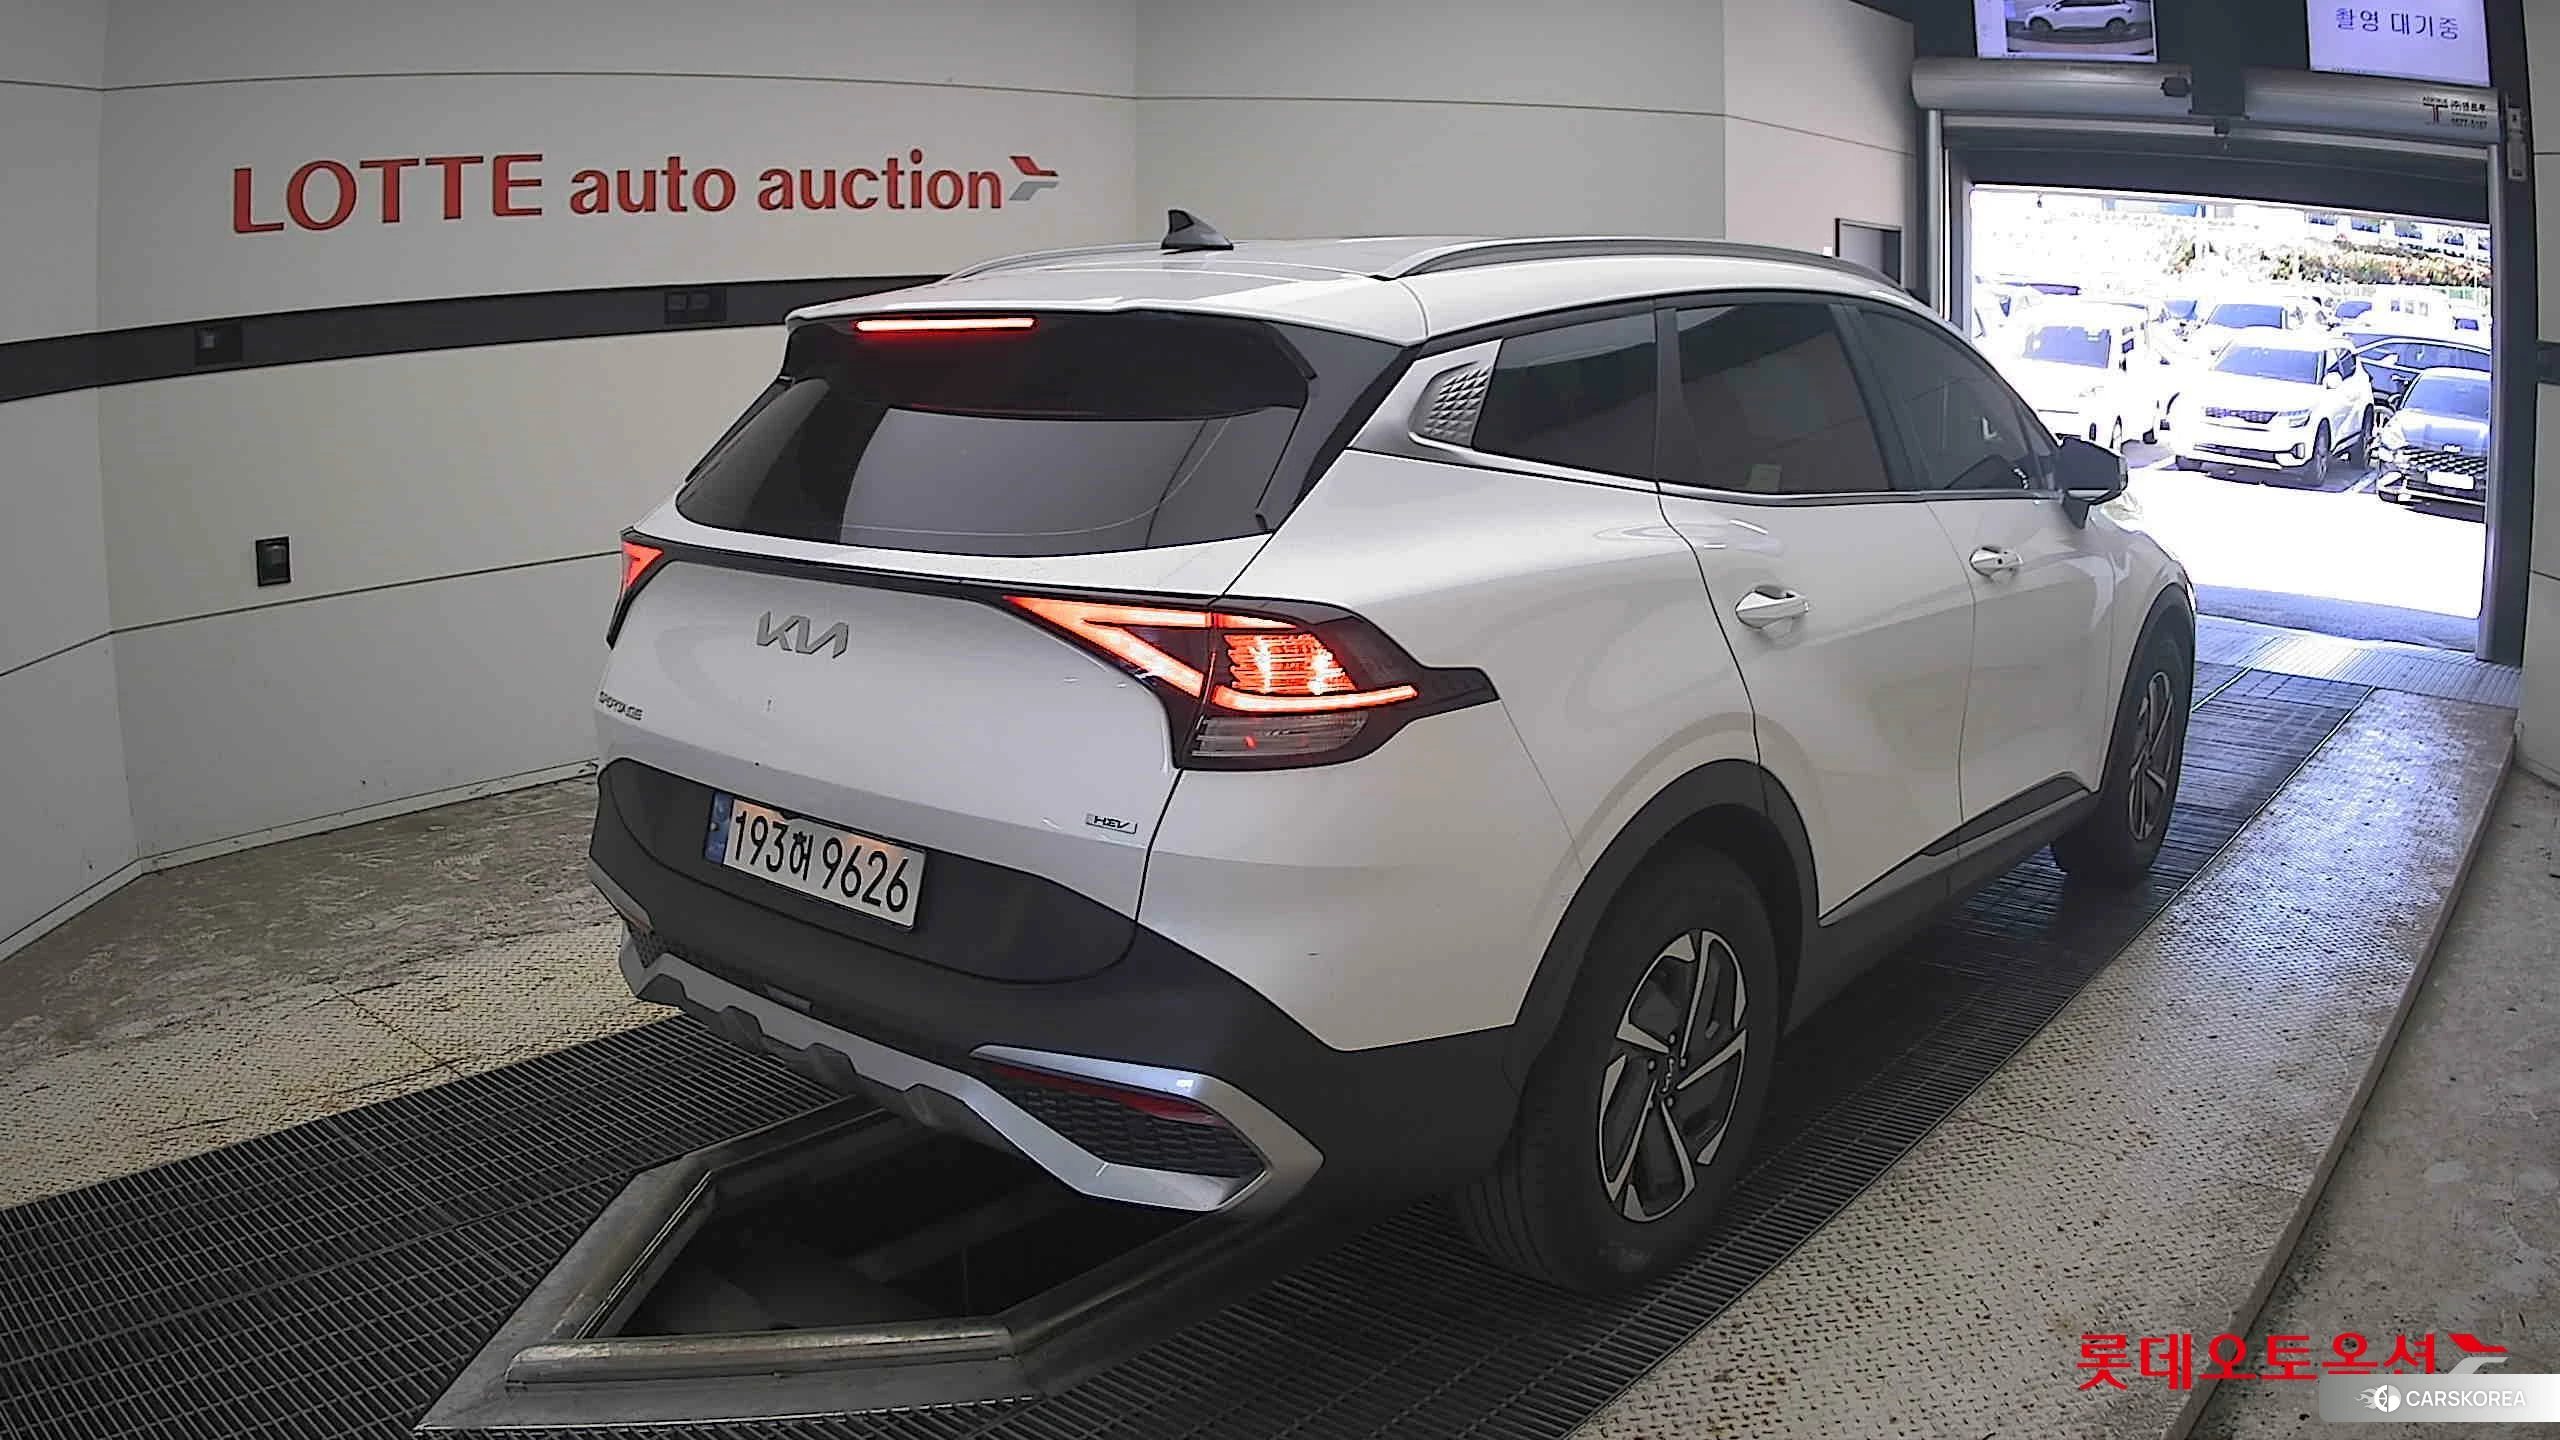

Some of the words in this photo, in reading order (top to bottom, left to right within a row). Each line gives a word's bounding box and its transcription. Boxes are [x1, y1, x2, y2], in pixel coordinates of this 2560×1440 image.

[2336, 8, 2379, 32] 촬영
[2391, 13, 2458, 40] 대기중
[233, 153, 543, 234] LOTTE
[571, 159, 736, 214] auto
[759, 151, 1004, 209] auction
[756, 610, 849, 659] KIA
[1093, 815, 1130, 829] HEV
[822, 837, 909, 912] 9626
